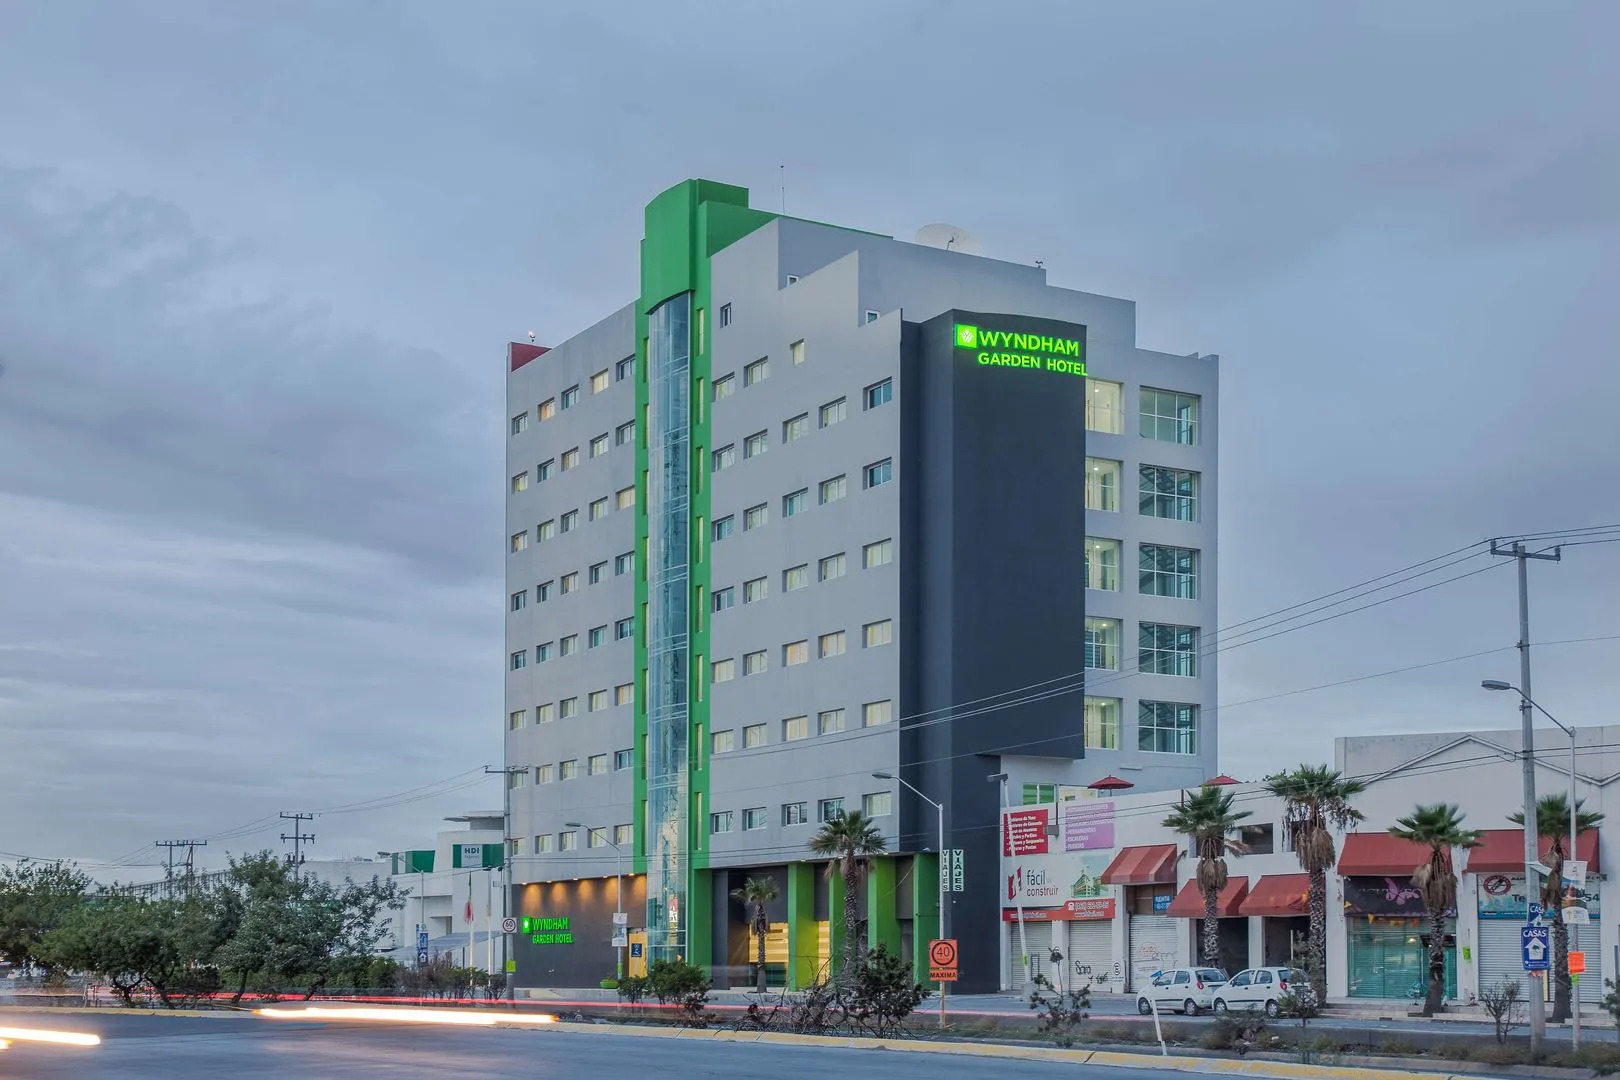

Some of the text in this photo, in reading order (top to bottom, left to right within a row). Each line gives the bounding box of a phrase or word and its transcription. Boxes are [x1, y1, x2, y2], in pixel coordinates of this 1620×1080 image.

[979, 331, 1079, 357] WYNDHAM
[978, 352, 1088, 376] GARDEN HOTEL
[954, 850, 962, 891] VIAJES
[1026, 869, 1046, 886] fácil
[1026, 886, 1059, 897] construir
[533, 917, 569, 930] WYNDHAM
[532, 933, 573, 944] GARDEN HOTEL
[1522, 930, 1547, 938] CASAS
[936, 946, 950, 957] 40
